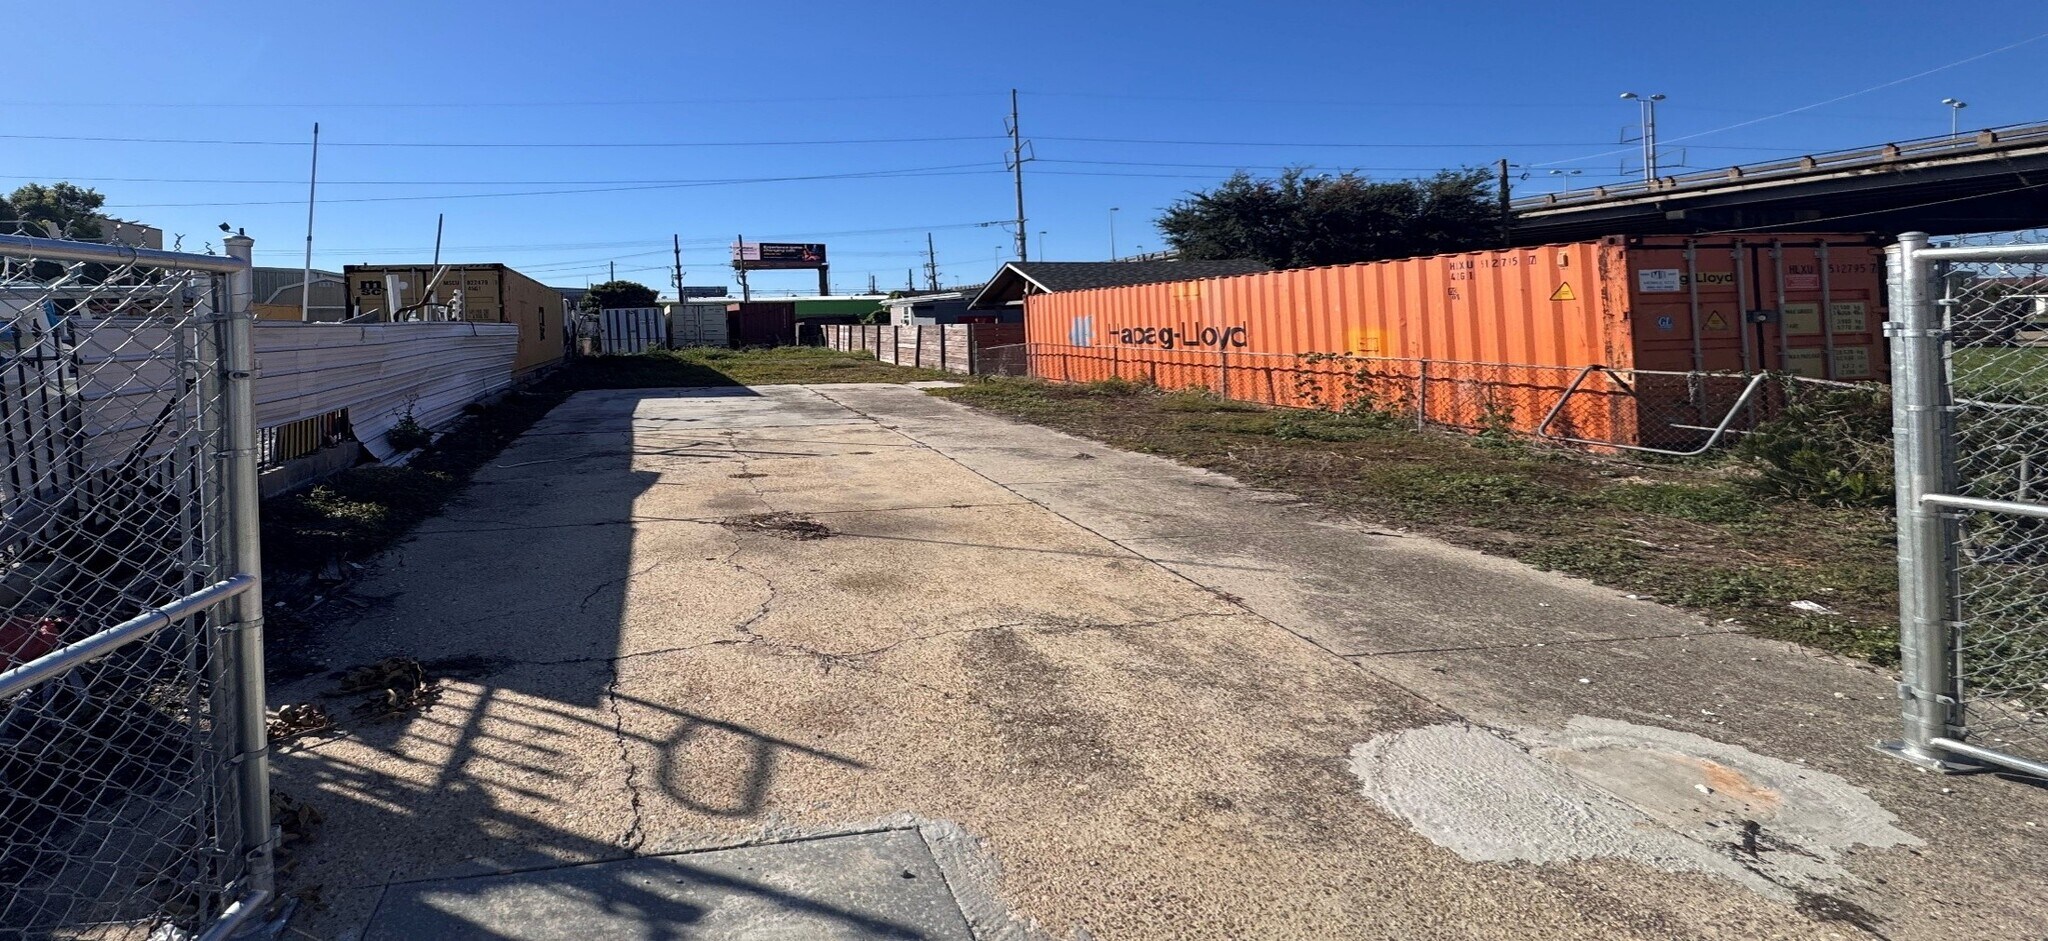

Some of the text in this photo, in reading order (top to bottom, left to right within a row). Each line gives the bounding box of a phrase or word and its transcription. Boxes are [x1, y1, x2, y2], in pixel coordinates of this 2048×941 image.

[1789, 264, 1813, 274] HLXU
[1828, 263, 1866, 273] 512795
[1658, 317, 1672, 328] GL
[1107, 321, 1248, 350] Hapag-Lloyd
